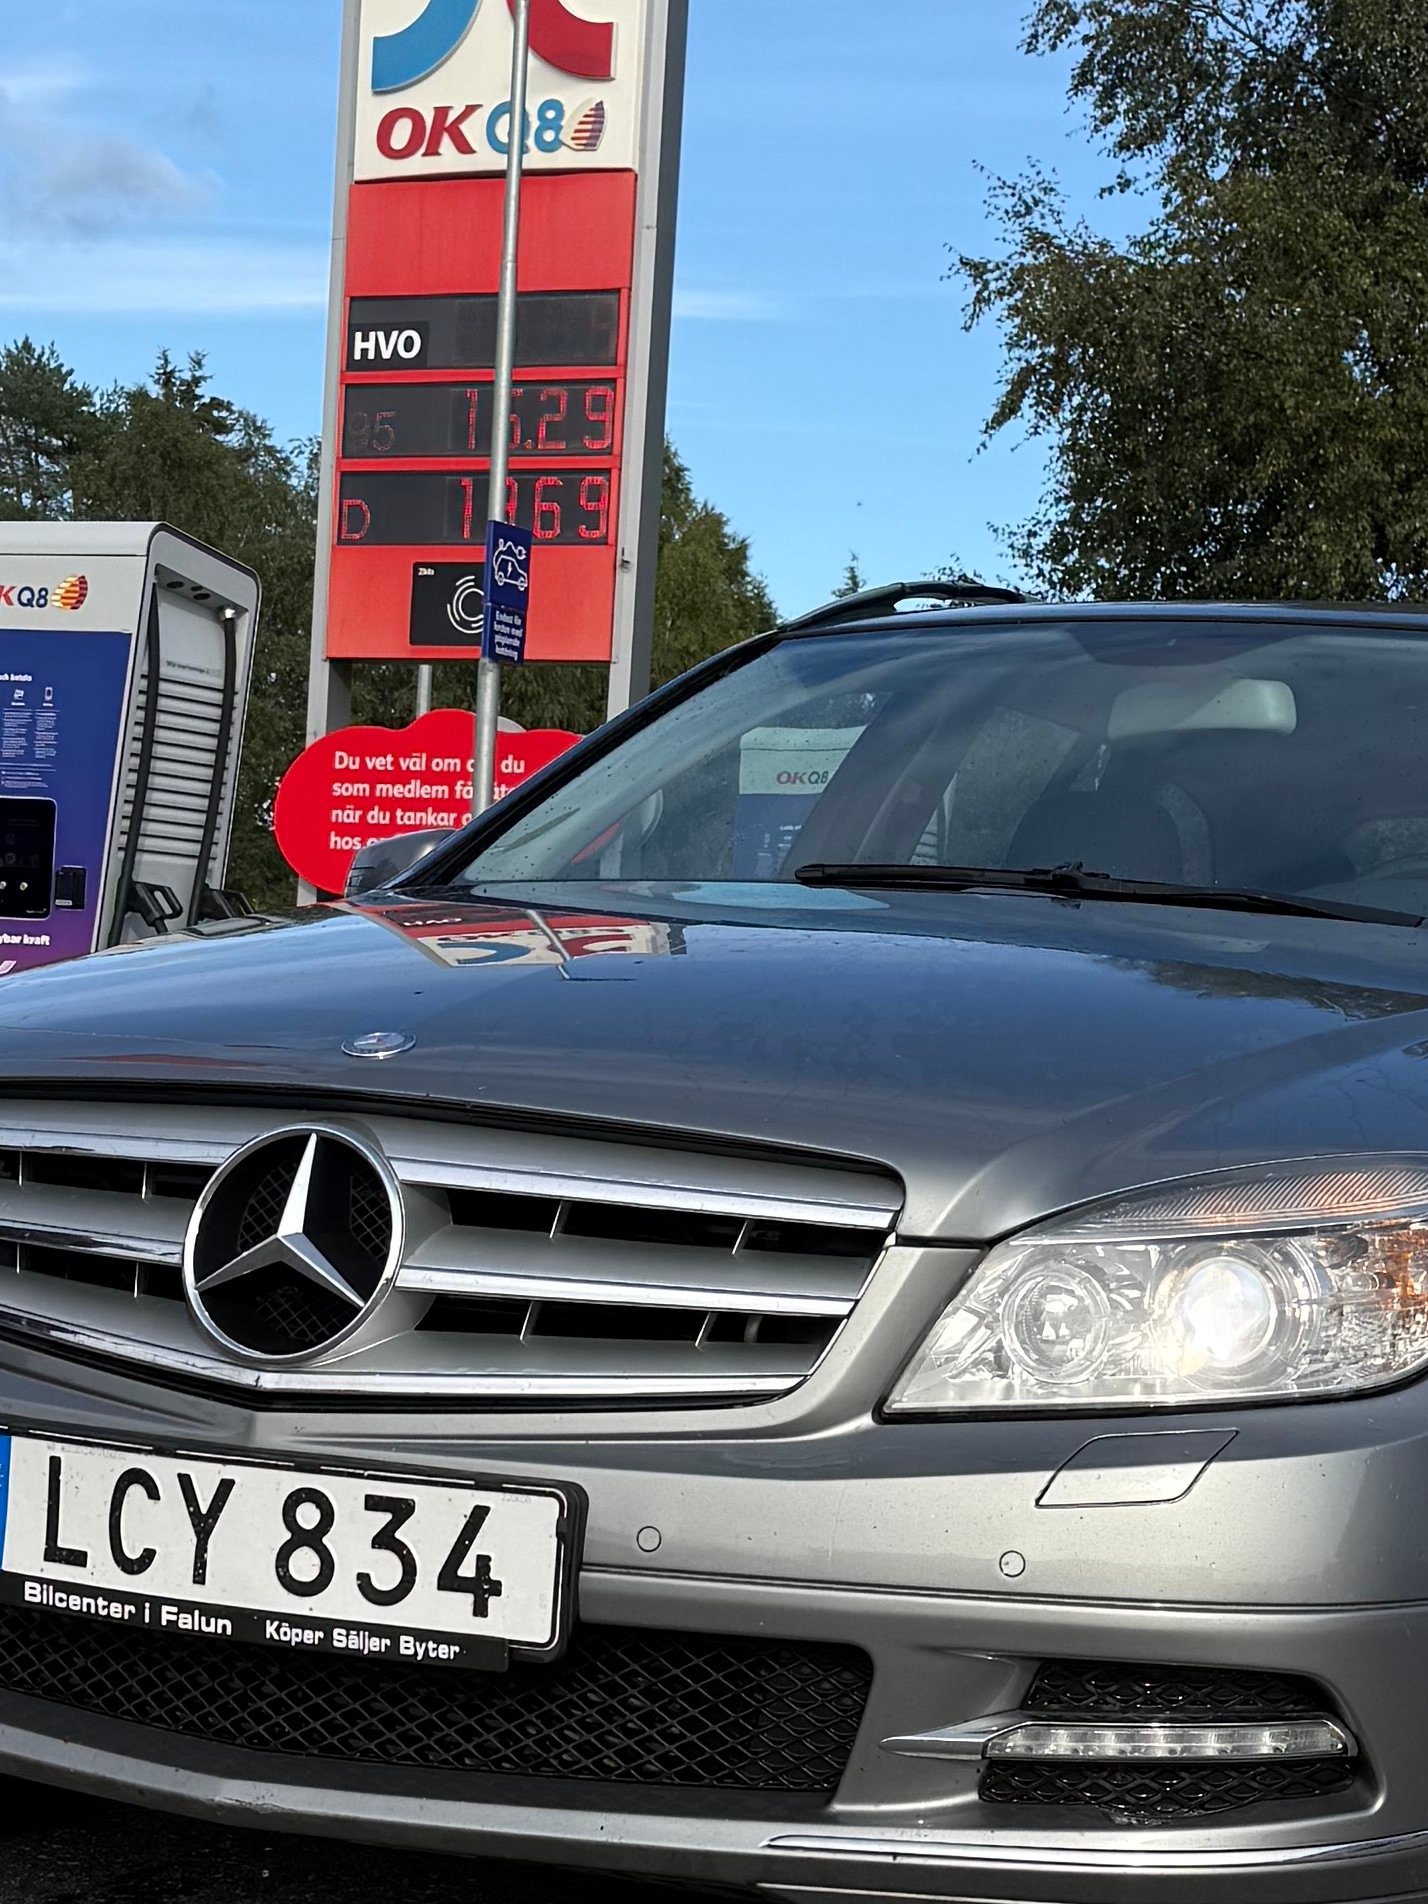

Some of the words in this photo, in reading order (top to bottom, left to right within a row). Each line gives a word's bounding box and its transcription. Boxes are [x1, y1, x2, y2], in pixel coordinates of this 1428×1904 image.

[376, 98, 565, 160] OKQ8
[353, 329, 422, 361] HVO
[341, 499, 370, 540] D
[334, 751, 360, 770] Du
[365, 754, 394, 771] vet
[399, 752, 426, 772] väl
[431, 758, 461, 772] om
[500, 754, 525, 773] du
[776, 770, 829, 784] OKQ8
[332, 782, 370, 797] som
[375, 779, 449, 799] medlem
[454, 780, 473, 799] få
[331, 805, 363, 823] när
[366, 805, 390, 824] du
[396, 807, 458, 826] tankar
[329, 831, 361, 850] hos
[23, 934, 50, 946] kraft
[43, 1455, 236, 1586] LCY
[275, 1487, 503, 1618] 834
[23, 1581, 135, 1621] Bilcenter
[144, 1602, 151, 1625] i
[160, 1606, 233, 1636] Falun
[265, 1619, 325, 1648] Köper
[331, 1626, 391, 1654] Säljer
[398, 1636, 460, 1664] Byter
